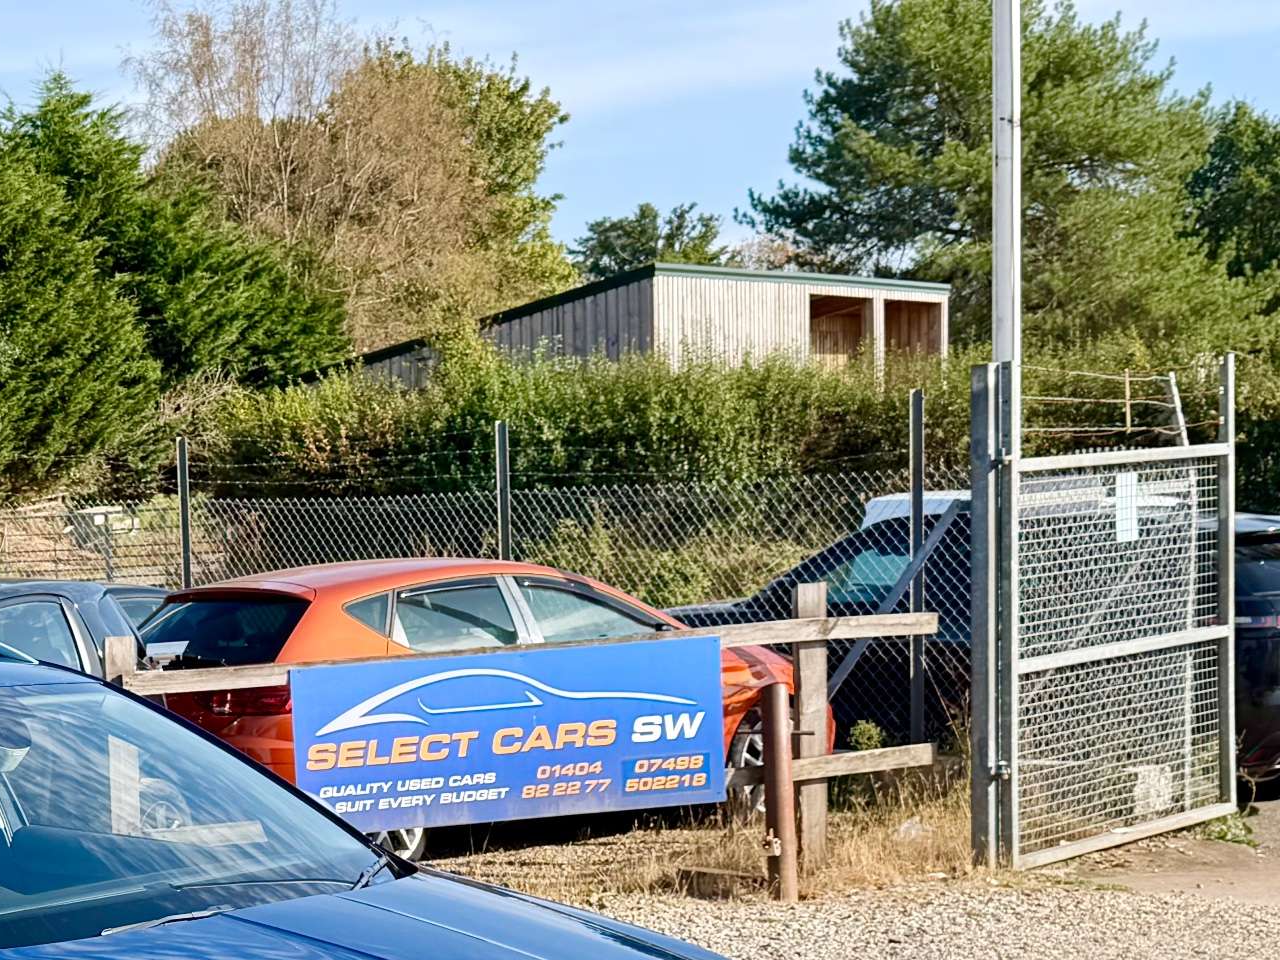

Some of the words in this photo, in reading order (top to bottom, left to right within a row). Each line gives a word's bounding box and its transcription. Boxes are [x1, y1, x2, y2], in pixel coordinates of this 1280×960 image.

[306, 731, 480, 771] SELECT
[492, 720, 618, 755] CARS
[631, 711, 706, 743] SW
[537, 761, 603, 779] 01404
[634, 755, 705, 773] 07498
[320, 781, 393, 798] QUALITY
[396, 777, 444, 791] USED
[448, 772, 497, 787] CARS
[522, 784, 550, 799] 82
[552, 781, 581, 797] 22
[584, 778, 612, 793] 77
[624, 773, 708, 792] 502218
[335, 799, 376, 813] SUIT
[378, 794, 436, 810] EVERY
[439, 787, 511, 804] BUDGET
